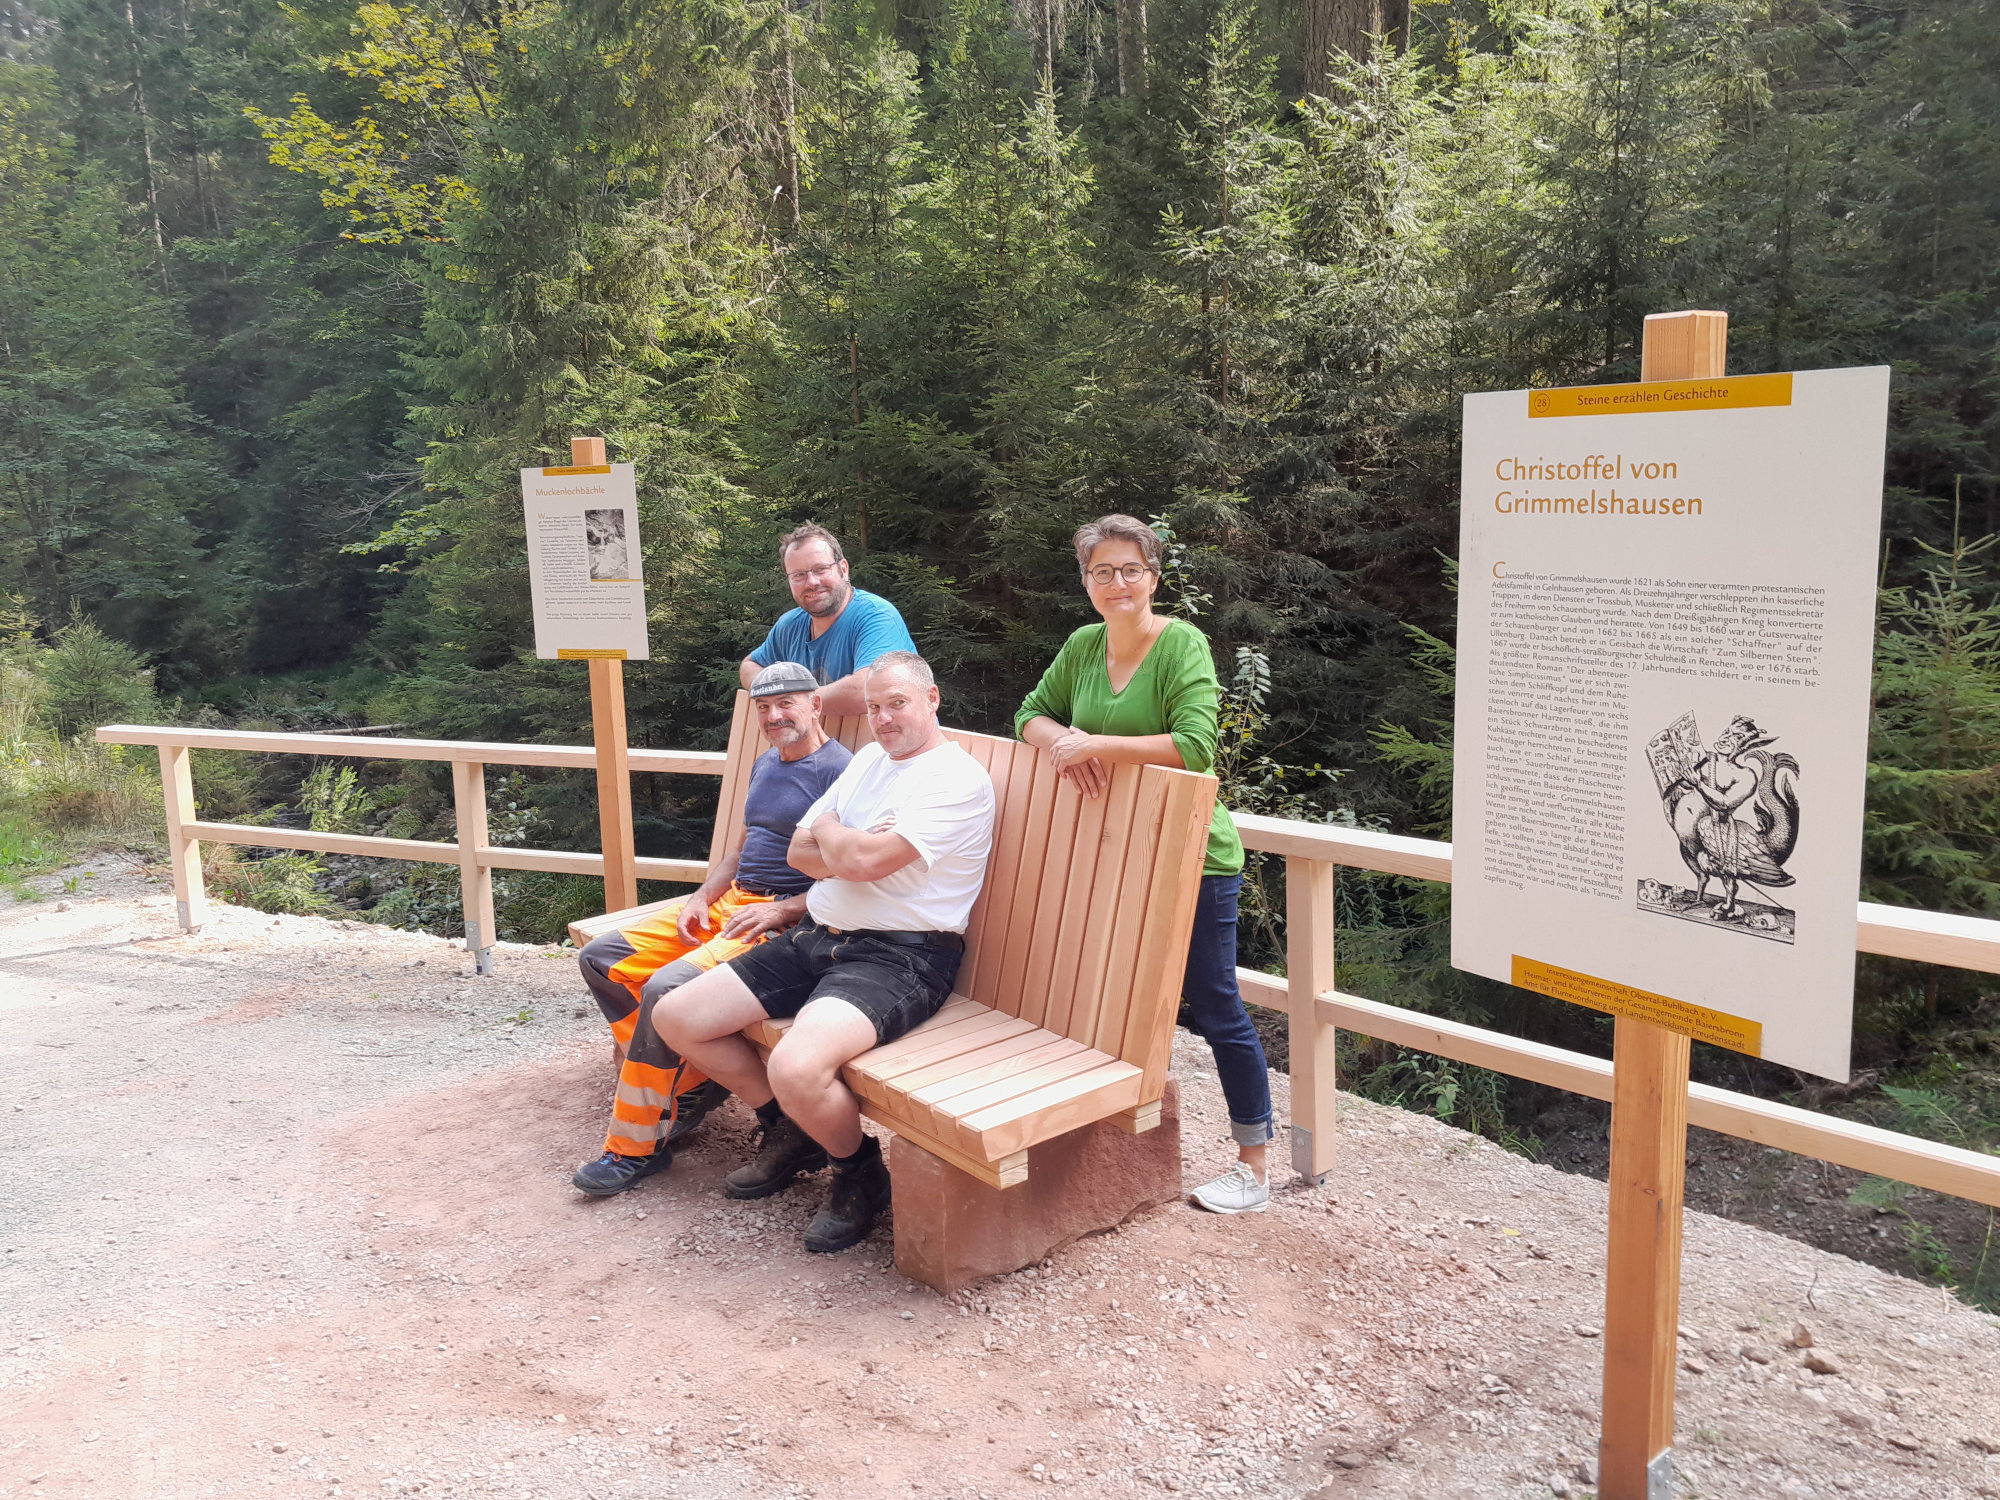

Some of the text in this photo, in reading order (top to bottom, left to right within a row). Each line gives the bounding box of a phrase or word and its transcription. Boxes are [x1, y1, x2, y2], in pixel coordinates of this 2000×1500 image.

[1536, 398, 1547, 408] 28
[1577, 386, 1729, 406] Steine erzählen Geschichte
[1495, 454, 1678, 481] Christoffel von
[535, 485, 606, 497] Muckenlochbächle
[1494, 488, 1702, 516] Grimmelshausen
[1491, 580, 1532, 590] Adelsfamilie
[1533, 582, 1540, 591] in
[1542, 583, 1583, 593] Gelnhausen
[1619, 587, 1631, 596] Als
[1633, 588, 1697, 601] Dreizehnjähriger
[1699, 591, 1758, 605] verschleppten
[1760, 594, 1774, 604] ihn
[1776, 595, 1824, 607] kaiserliche
[1549, 573, 1608, 584] Grimmelshausen
[1609, 576, 1632, 585] wurde
[1634, 577, 1651, 586] 1621
[1654, 578, 1664, 587] als
[1666, 578, 1686, 588] Sohn
[1687, 579, 1706, 589] einer
[1708, 580, 1750, 591] verarmten
[1752, 582, 1824, 597] protestantischen
[1491, 600, 1502, 608] des
[1552, 604, 1600, 617] Schauenburg
[1631, 609, 1651, 618] Nach
[1653, 610, 1671, 620] dem
[1674, 611, 1738, 626] Dreißigjährigen
[1741, 616, 1764, 628] Krieg
[1767, 617, 1823, 630] konvertierte
[1523, 592, 1529, 600] in
[1531, 592, 1551, 601] deren
[1553, 594, 1585, 603] Diensten
[1635, 598, 1674, 609] Musketier
[1676, 601, 1692, 610] und
[1694, 602, 1737, 613] schließlich
[1740, 604, 1823, 620] Regimentssekretär
[1490, 619, 1502, 627] der
[1504, 620, 1559, 634] Schauenburger
[1562, 624, 1577, 633] und
[1598, 627, 1617, 636] 1662
[1620, 629, 1632, 638] bis
[1636, 630, 1656, 640] 1665
[1659, 632, 1671, 641] als
[1674, 633, 1687, 642] ein
[1690, 634, 1722, 645] solcher
[1786, 641, 1803, 651] auf
[1805, 643, 1822, 653] der
[1515, 611, 1559, 622] katholischen
[1560, 614, 1591, 624] Glauben
[1593, 616, 1608, 625] und
[1648, 620, 1664, 630] Von
[1667, 622, 1688, 631] 1649
[1690, 623, 1702, 632] bis
[1705, 624, 1726, 634] 1660
[1728, 628, 1745, 636] war
[1758, 628, 1822, 641] Gutsverwalter
[1491, 638, 1507, 647] 1667
[1509, 640, 1530, 649] wurde
[1541, 643, 1642, 661] bischöflich-straßburgischer
[1644, 652, 1686, 664] Schultheiß
[1688, 656, 1696, 665] in
[1740, 662, 1753, 670] wo
[1768, 663, 1791, 673] 1676
[1529, 632, 1557, 642] Danach
[1560, 634, 1586, 644] betrieb
[1599, 637, 1606, 646] in
[1608, 638, 1645, 649] Geisbach
[1647, 641, 1660, 651] die
[1662, 643, 1708, 655] Wirtschaft
[1739, 649, 1783, 661] Silbernen
[1489, 648, 1500, 656] Als
[1502, 649, 1529, 661] größter
[1532, 652, 1607, 667] Romanschriftsteller
[1609, 659, 1623, 668] des
[1642, 662, 1697, 677] Jahrhunderts
[1700, 667, 1739, 680] schildert
[1755, 673, 1763, 682] in
[1767, 674, 1800, 686] seinem
